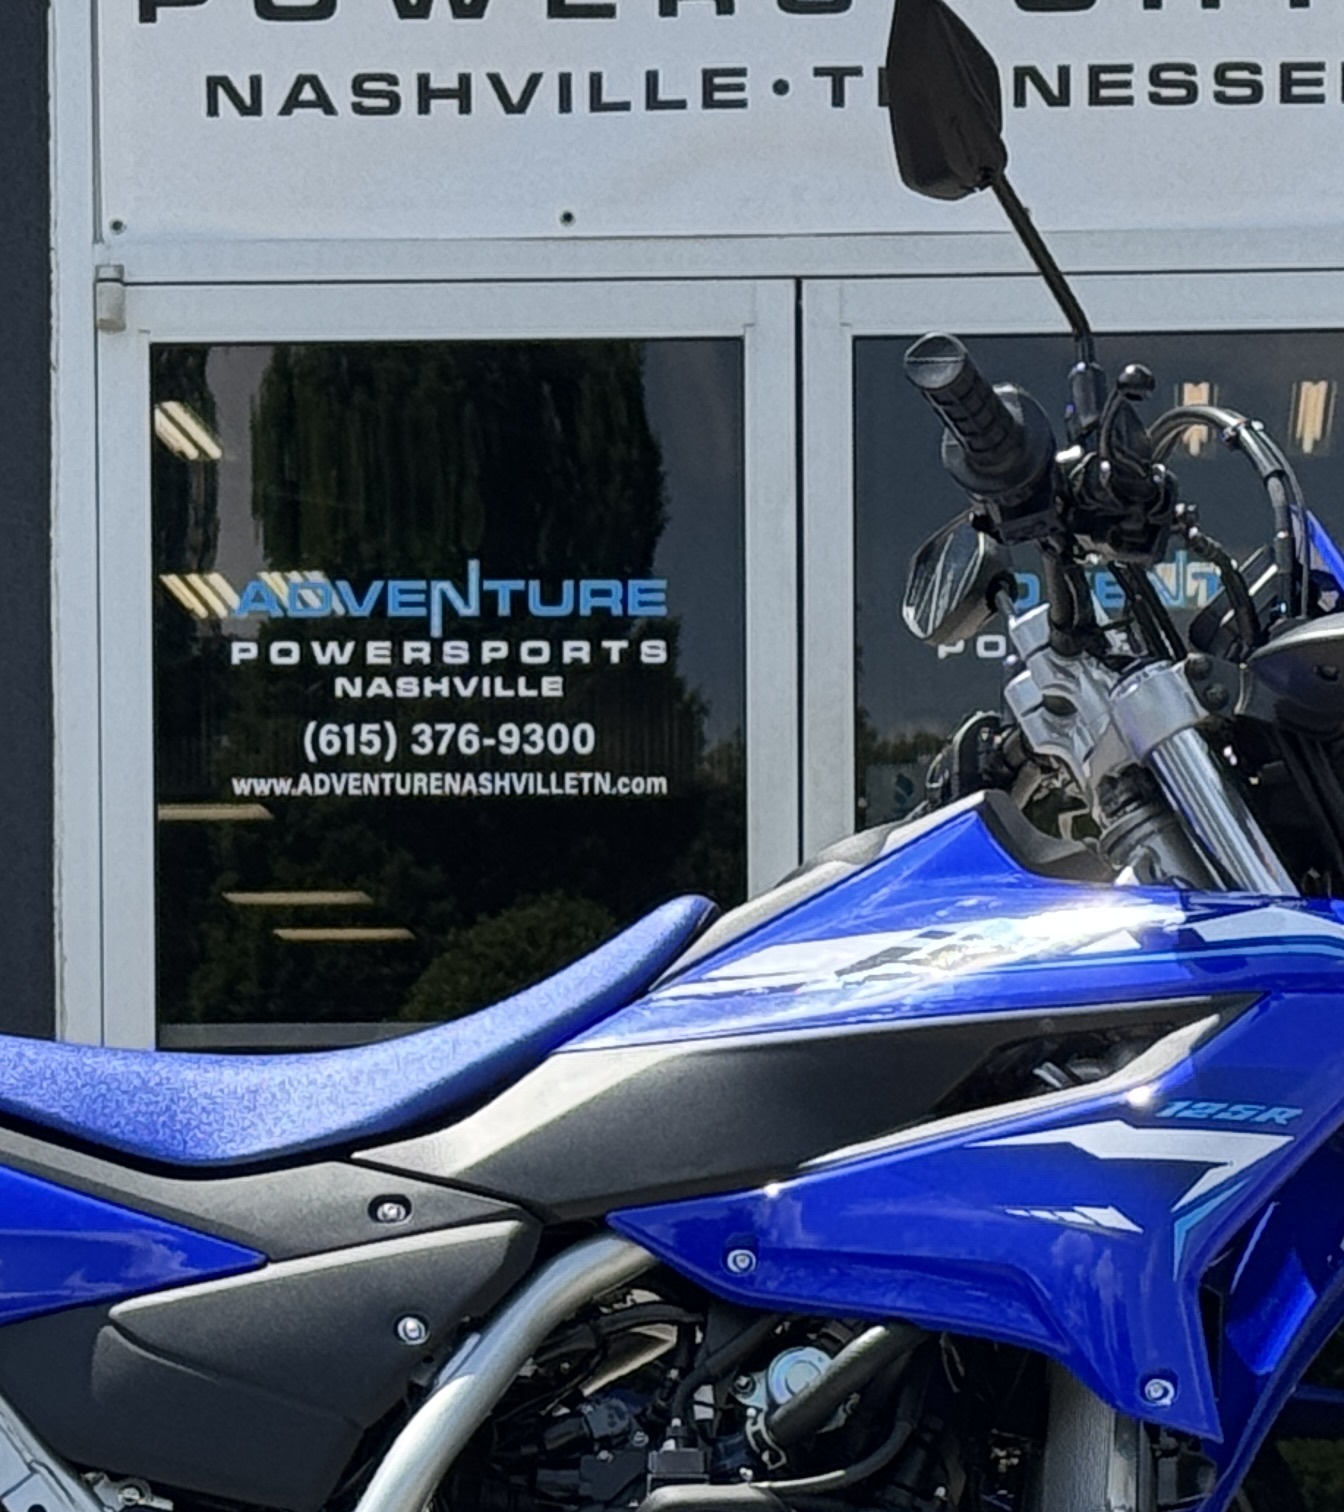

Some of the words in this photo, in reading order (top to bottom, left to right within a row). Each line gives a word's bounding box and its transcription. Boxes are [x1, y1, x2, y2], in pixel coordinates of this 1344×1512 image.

[206, 66, 750, 118] NASHVILLE
[233, 559, 668, 638] ADVENTURE
[231, 640, 668, 666] POWERSPORTS
[335, 676, 564, 698] NASHVILLE
[303, 721, 396, 763] (615)
[411, 723, 596, 756] 376-9300
[232, 772, 668, 796] www.ADVENTURENASHVILLETN.com
[1155, 1101, 1304, 1125] 125R
